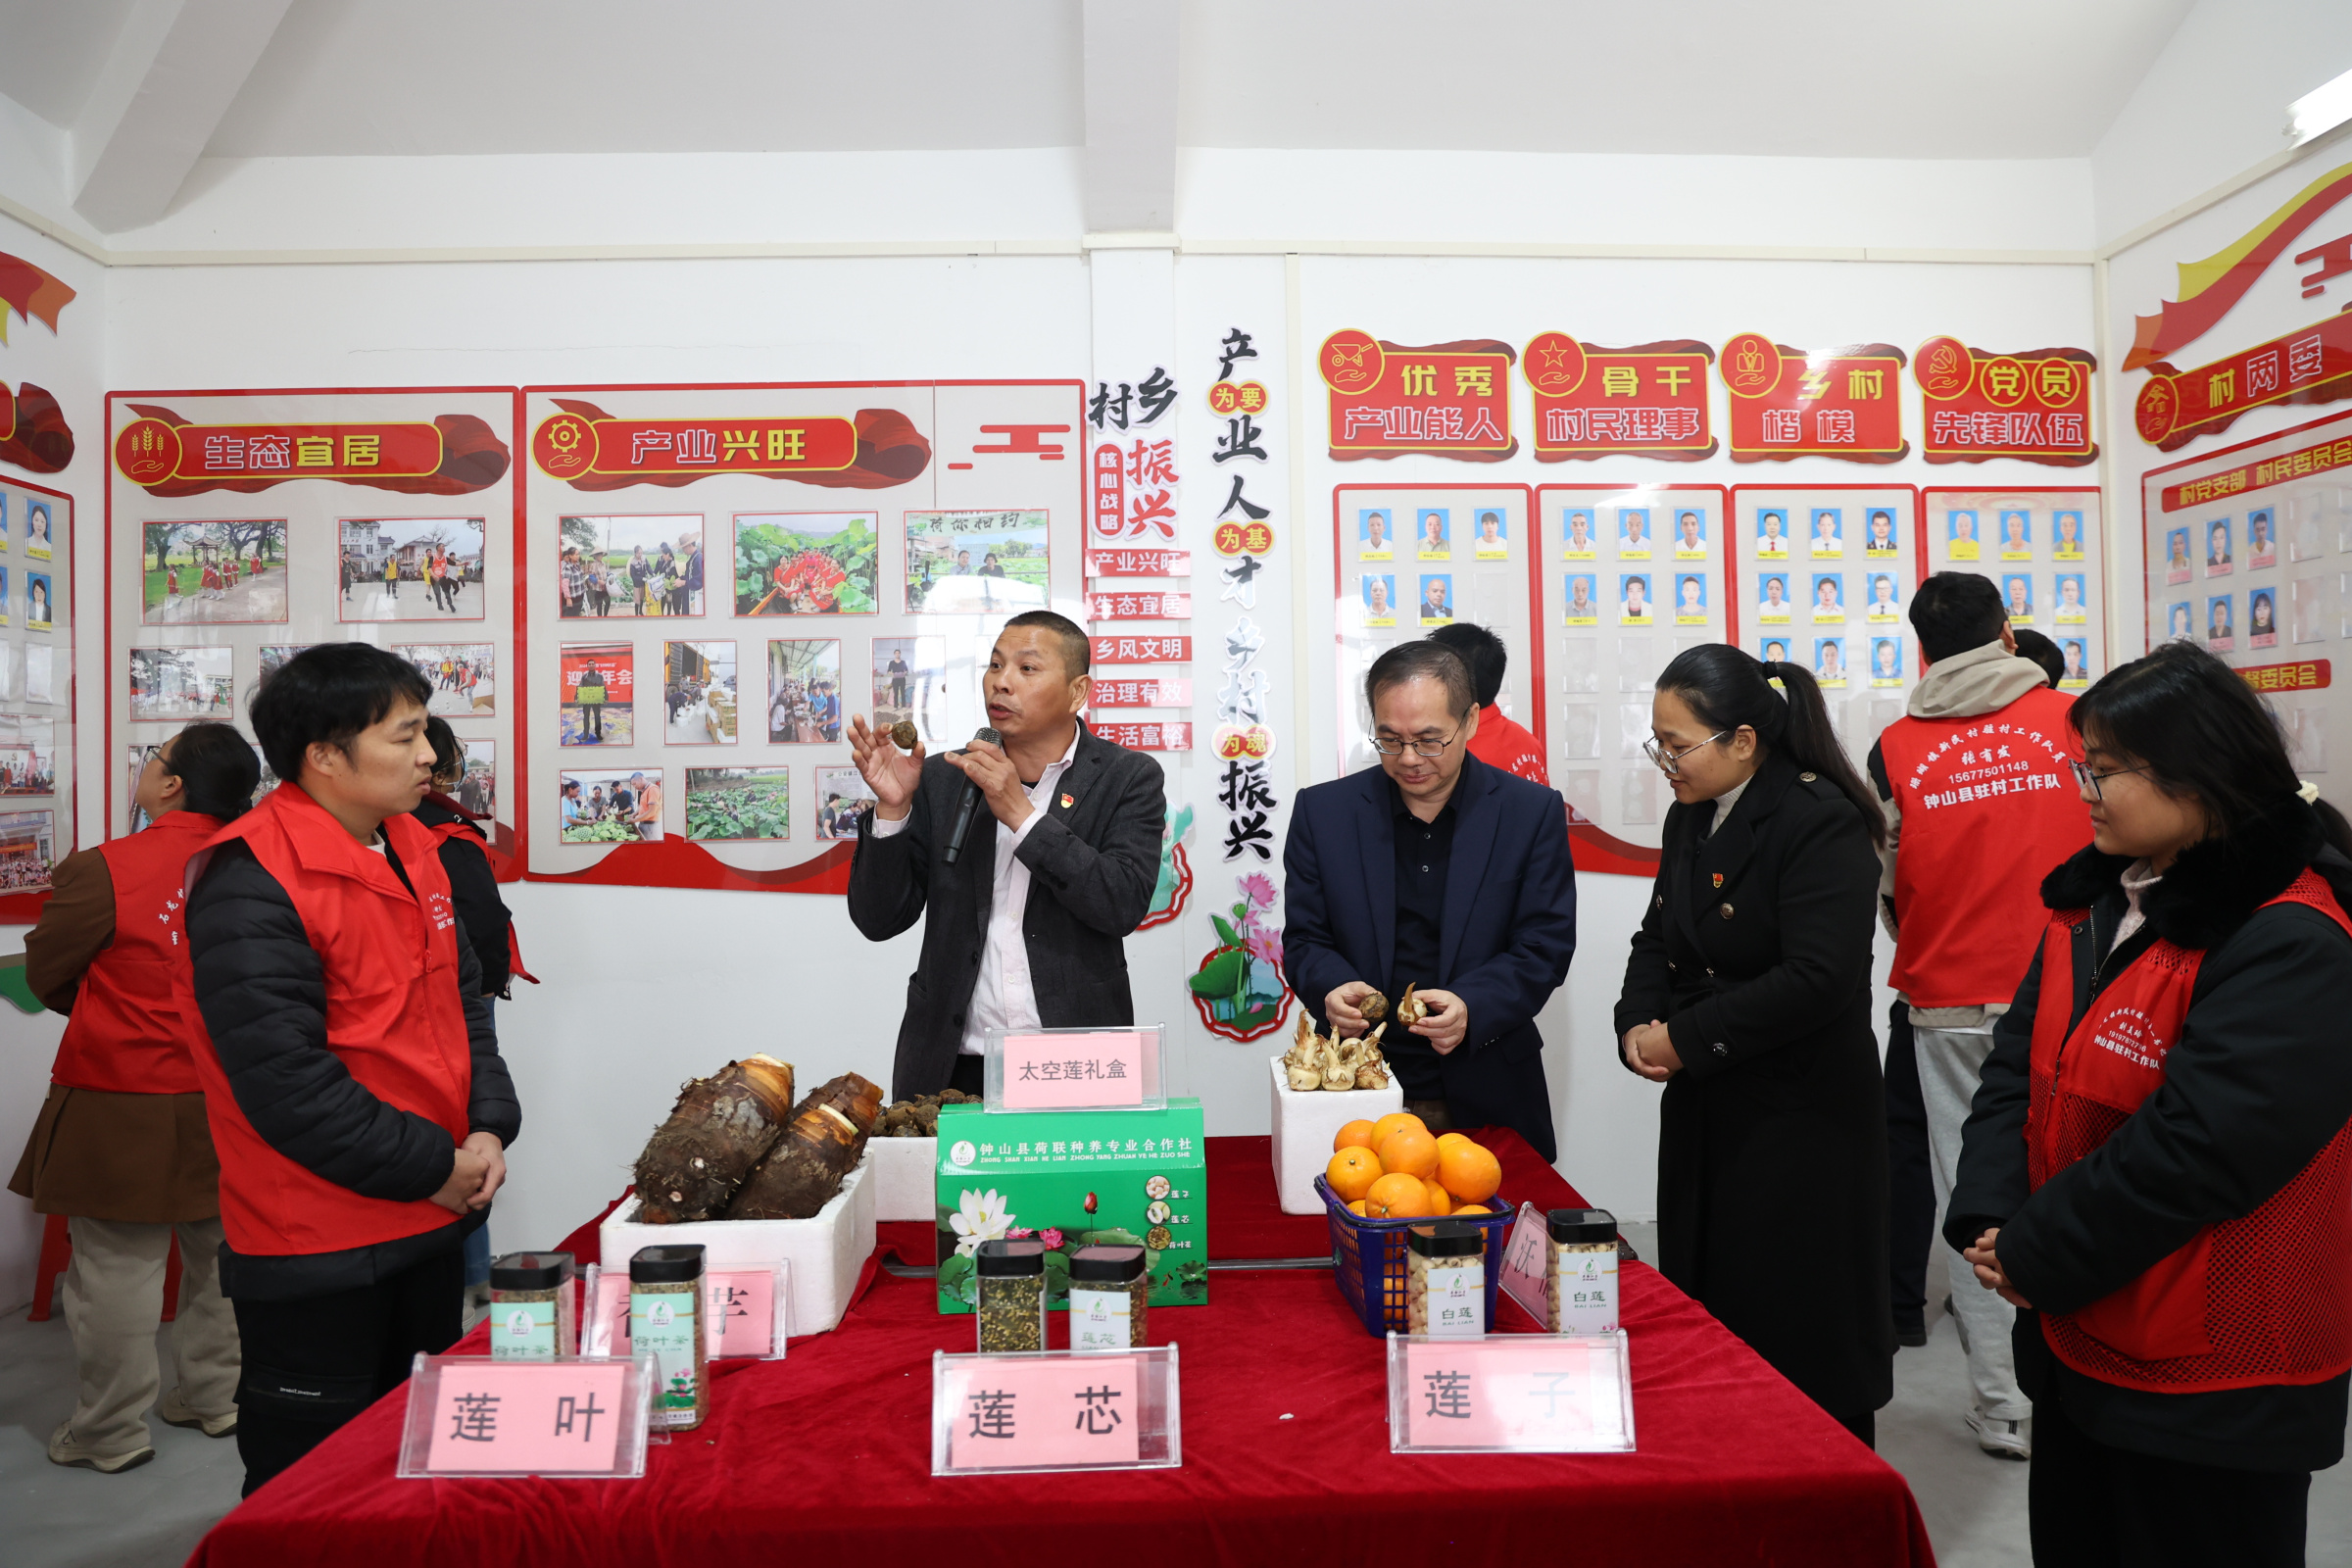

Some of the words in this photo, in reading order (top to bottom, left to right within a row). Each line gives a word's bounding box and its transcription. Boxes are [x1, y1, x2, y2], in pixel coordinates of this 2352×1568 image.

[1400, 365, 1494, 397] 优秀
[1601, 366, 1692, 397] 骨干
[1797, 368, 1885, 400] 乡村
[1987, 366, 2072, 399] 党员
[1215, 387, 1262, 410] 为要
[1344, 407, 1504, 441] 产业能人
[1545, 408, 1699, 441] 村民理事
[1762, 409, 1856, 444] 楷模
[1933, 411, 2084, 447] 先锋队伍
[204, 434, 381, 469] 生态宜居
[630, 428, 807, 465] 产业兴旺
[1126, 438, 1180, 538] 振兴
[2179, 468, 2247, 506] 村党支部
[2256, 439, 2352, 486] 村民委员会
[1099, 451, 1119, 531] 核心战略
[929, 512, 1020, 533] 荷你相约
[1221, 527, 1268, 550] 为基
[1095, 552, 1181, 572] 产业兴旺
[1095, 595, 1181, 616] 生态宜居
[1096, 638, 1182, 660] 乡风文明
[566, 669, 633, 686] 迎年会
[1096, 681, 1182, 704] 治理有效
[1096, 724, 1184, 747] 生活富裕
[1221, 732, 1268, 754] 为魂
[1948, 760, 2029, 784] 15677501148
[1923, 773, 2062, 810] 钟山县驻村工作队
[2093, 1034, 2160, 1070] 钟山县驻村工作队
[1018, 1058, 1128, 1082] 太空莲礼盒
[980, 1137, 1193, 1156] 钟山县荷联种养专业合作社
[1573, 1291, 1606, 1302] 白莲
[1442, 1307, 1474, 1320] 白莲
[1423, 1370, 1576, 1419] 莲子
[450, 1392, 606, 1443] 莲叶
[968, 1385, 1122, 1440] 莲芯
